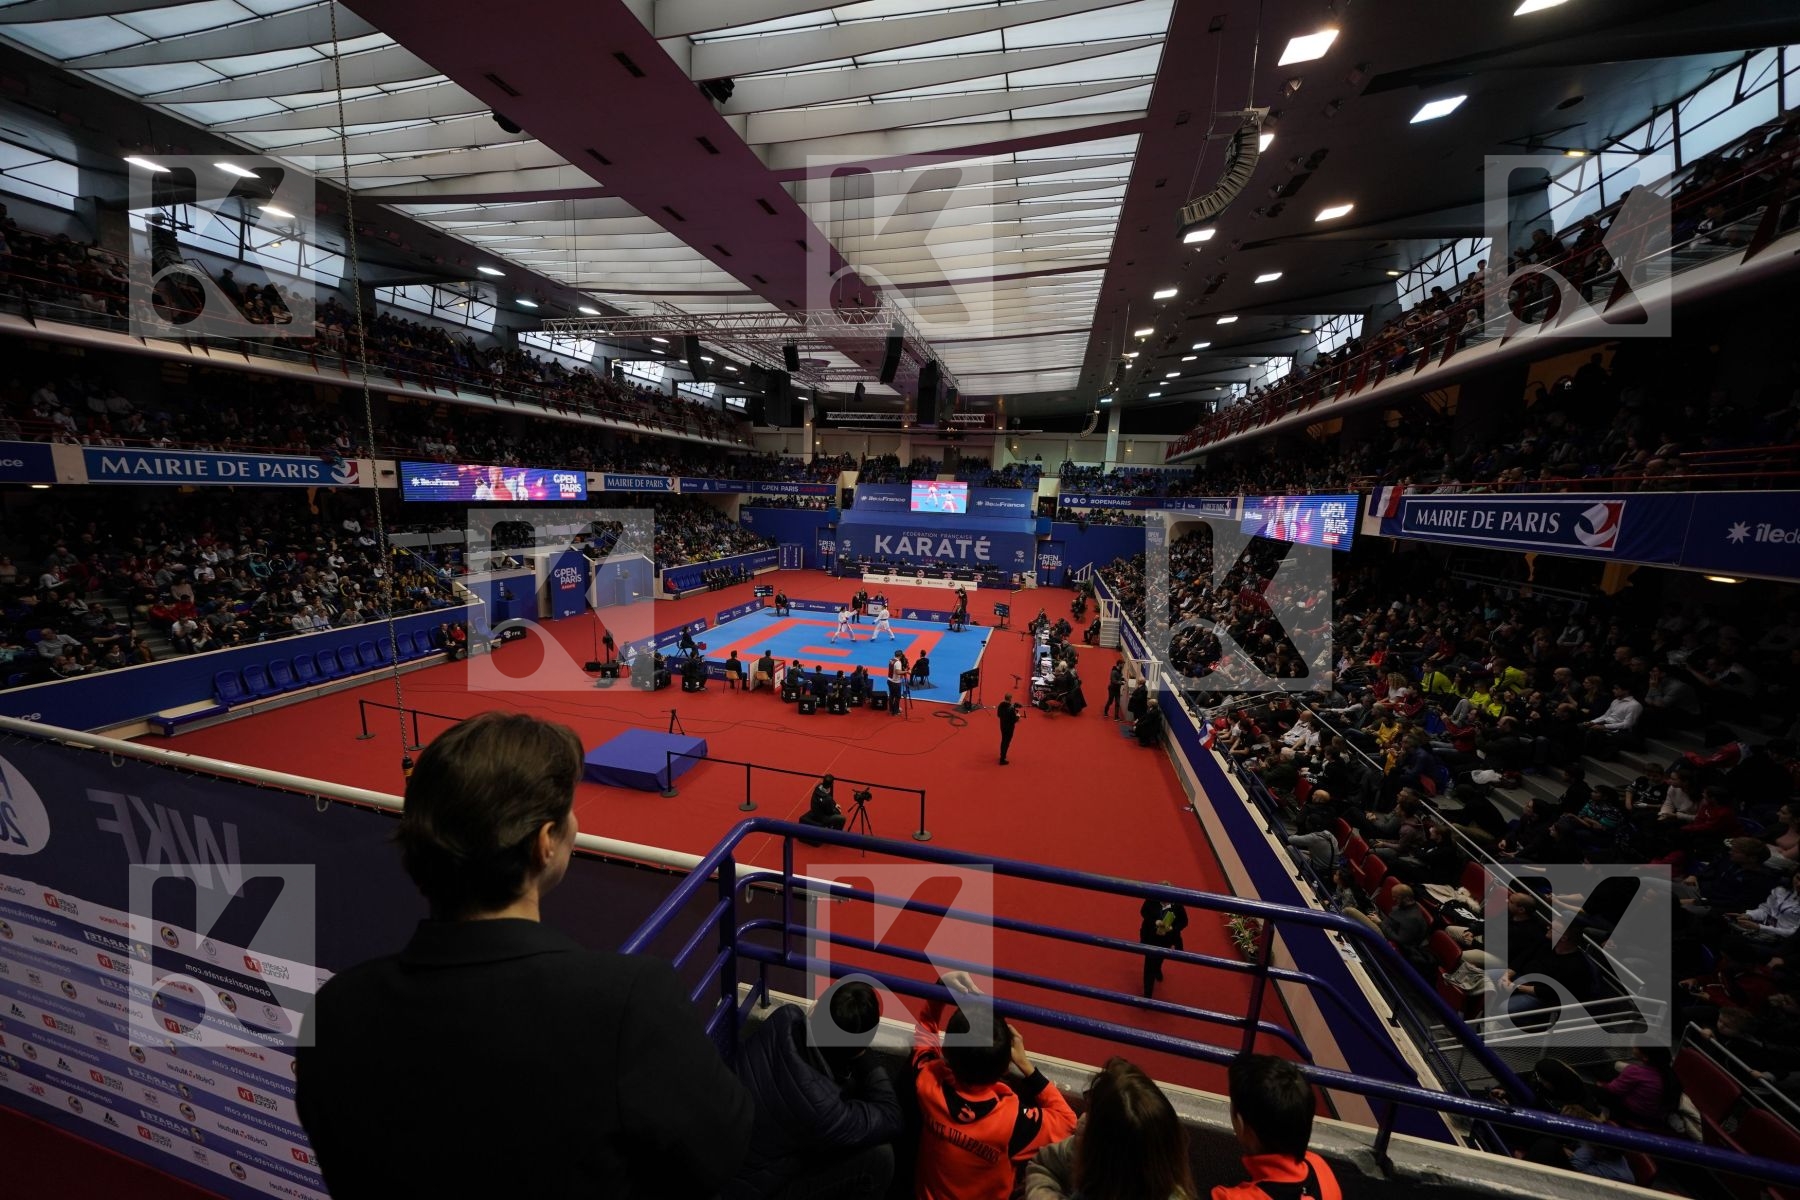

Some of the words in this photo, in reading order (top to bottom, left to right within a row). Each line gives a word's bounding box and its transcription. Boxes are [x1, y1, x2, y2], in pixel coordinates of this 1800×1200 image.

[102, 456, 209, 477] MAIRIE
[217, 461, 251, 477] DE
[258, 462, 320, 478] PARIS
[553, 474, 577, 484] OPEN
[607, 478, 634, 488] MAIRIE
[635, 479, 645, 488] DE
[646, 480, 664, 488] PARIS
[559, 483, 582, 493] PARIS
[761, 484, 779, 492] OPEN
[781, 485, 799, 493] PARIS
[1414, 508, 1467, 529] MAIRIE
[1470, 510, 1495, 531] DE
[1499, 511, 1561, 535] PARIS
[874, 534, 991, 561] KARATÉ
[1038, 554, 1059, 562] OPEN
[1042, 559, 1062, 567] PARIS
[554, 566, 578, 578] OPEN
[560, 574, 582, 585] PARIS
